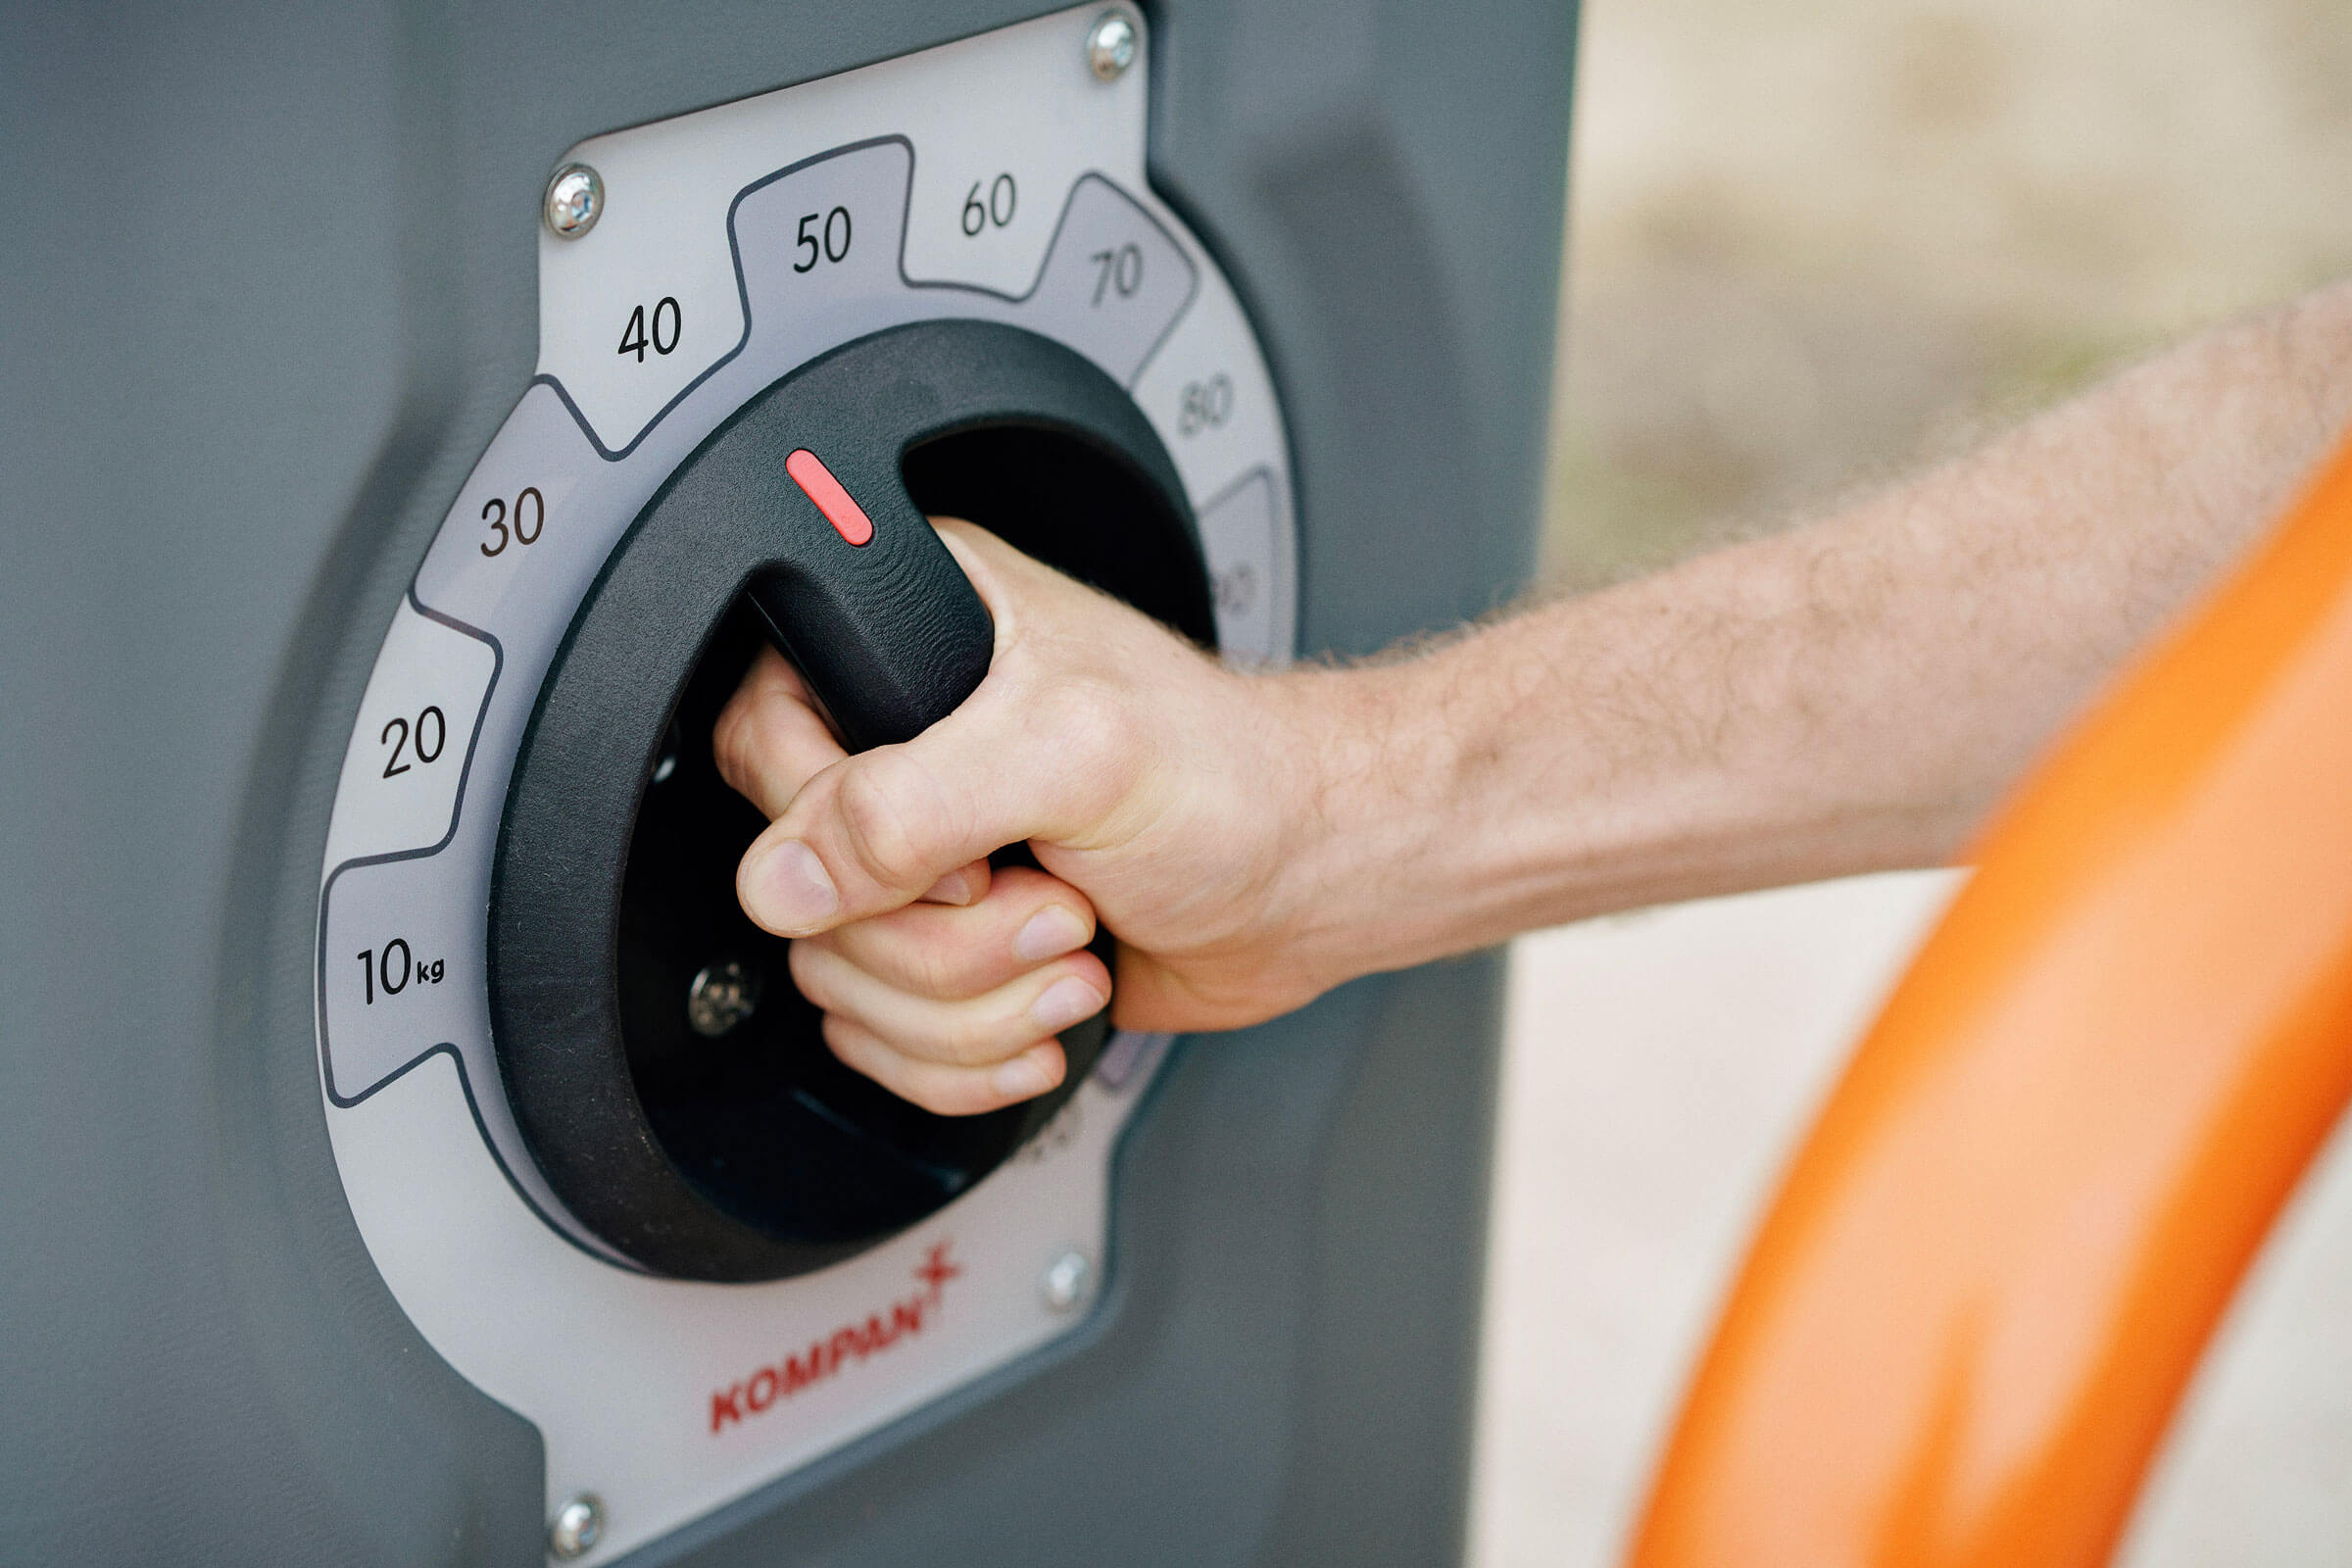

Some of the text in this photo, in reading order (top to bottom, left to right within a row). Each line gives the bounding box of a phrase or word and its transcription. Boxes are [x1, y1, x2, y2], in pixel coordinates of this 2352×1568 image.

[961, 172, 1016, 237] 60
[793, 206, 852, 273] 50
[1090, 242, 1144, 307] 70
[617, 296, 682, 364] 40
[480, 486, 545, 558] 30
[380, 705, 446, 779] 20
[710, 1294, 924, 1434] KOMPAN
